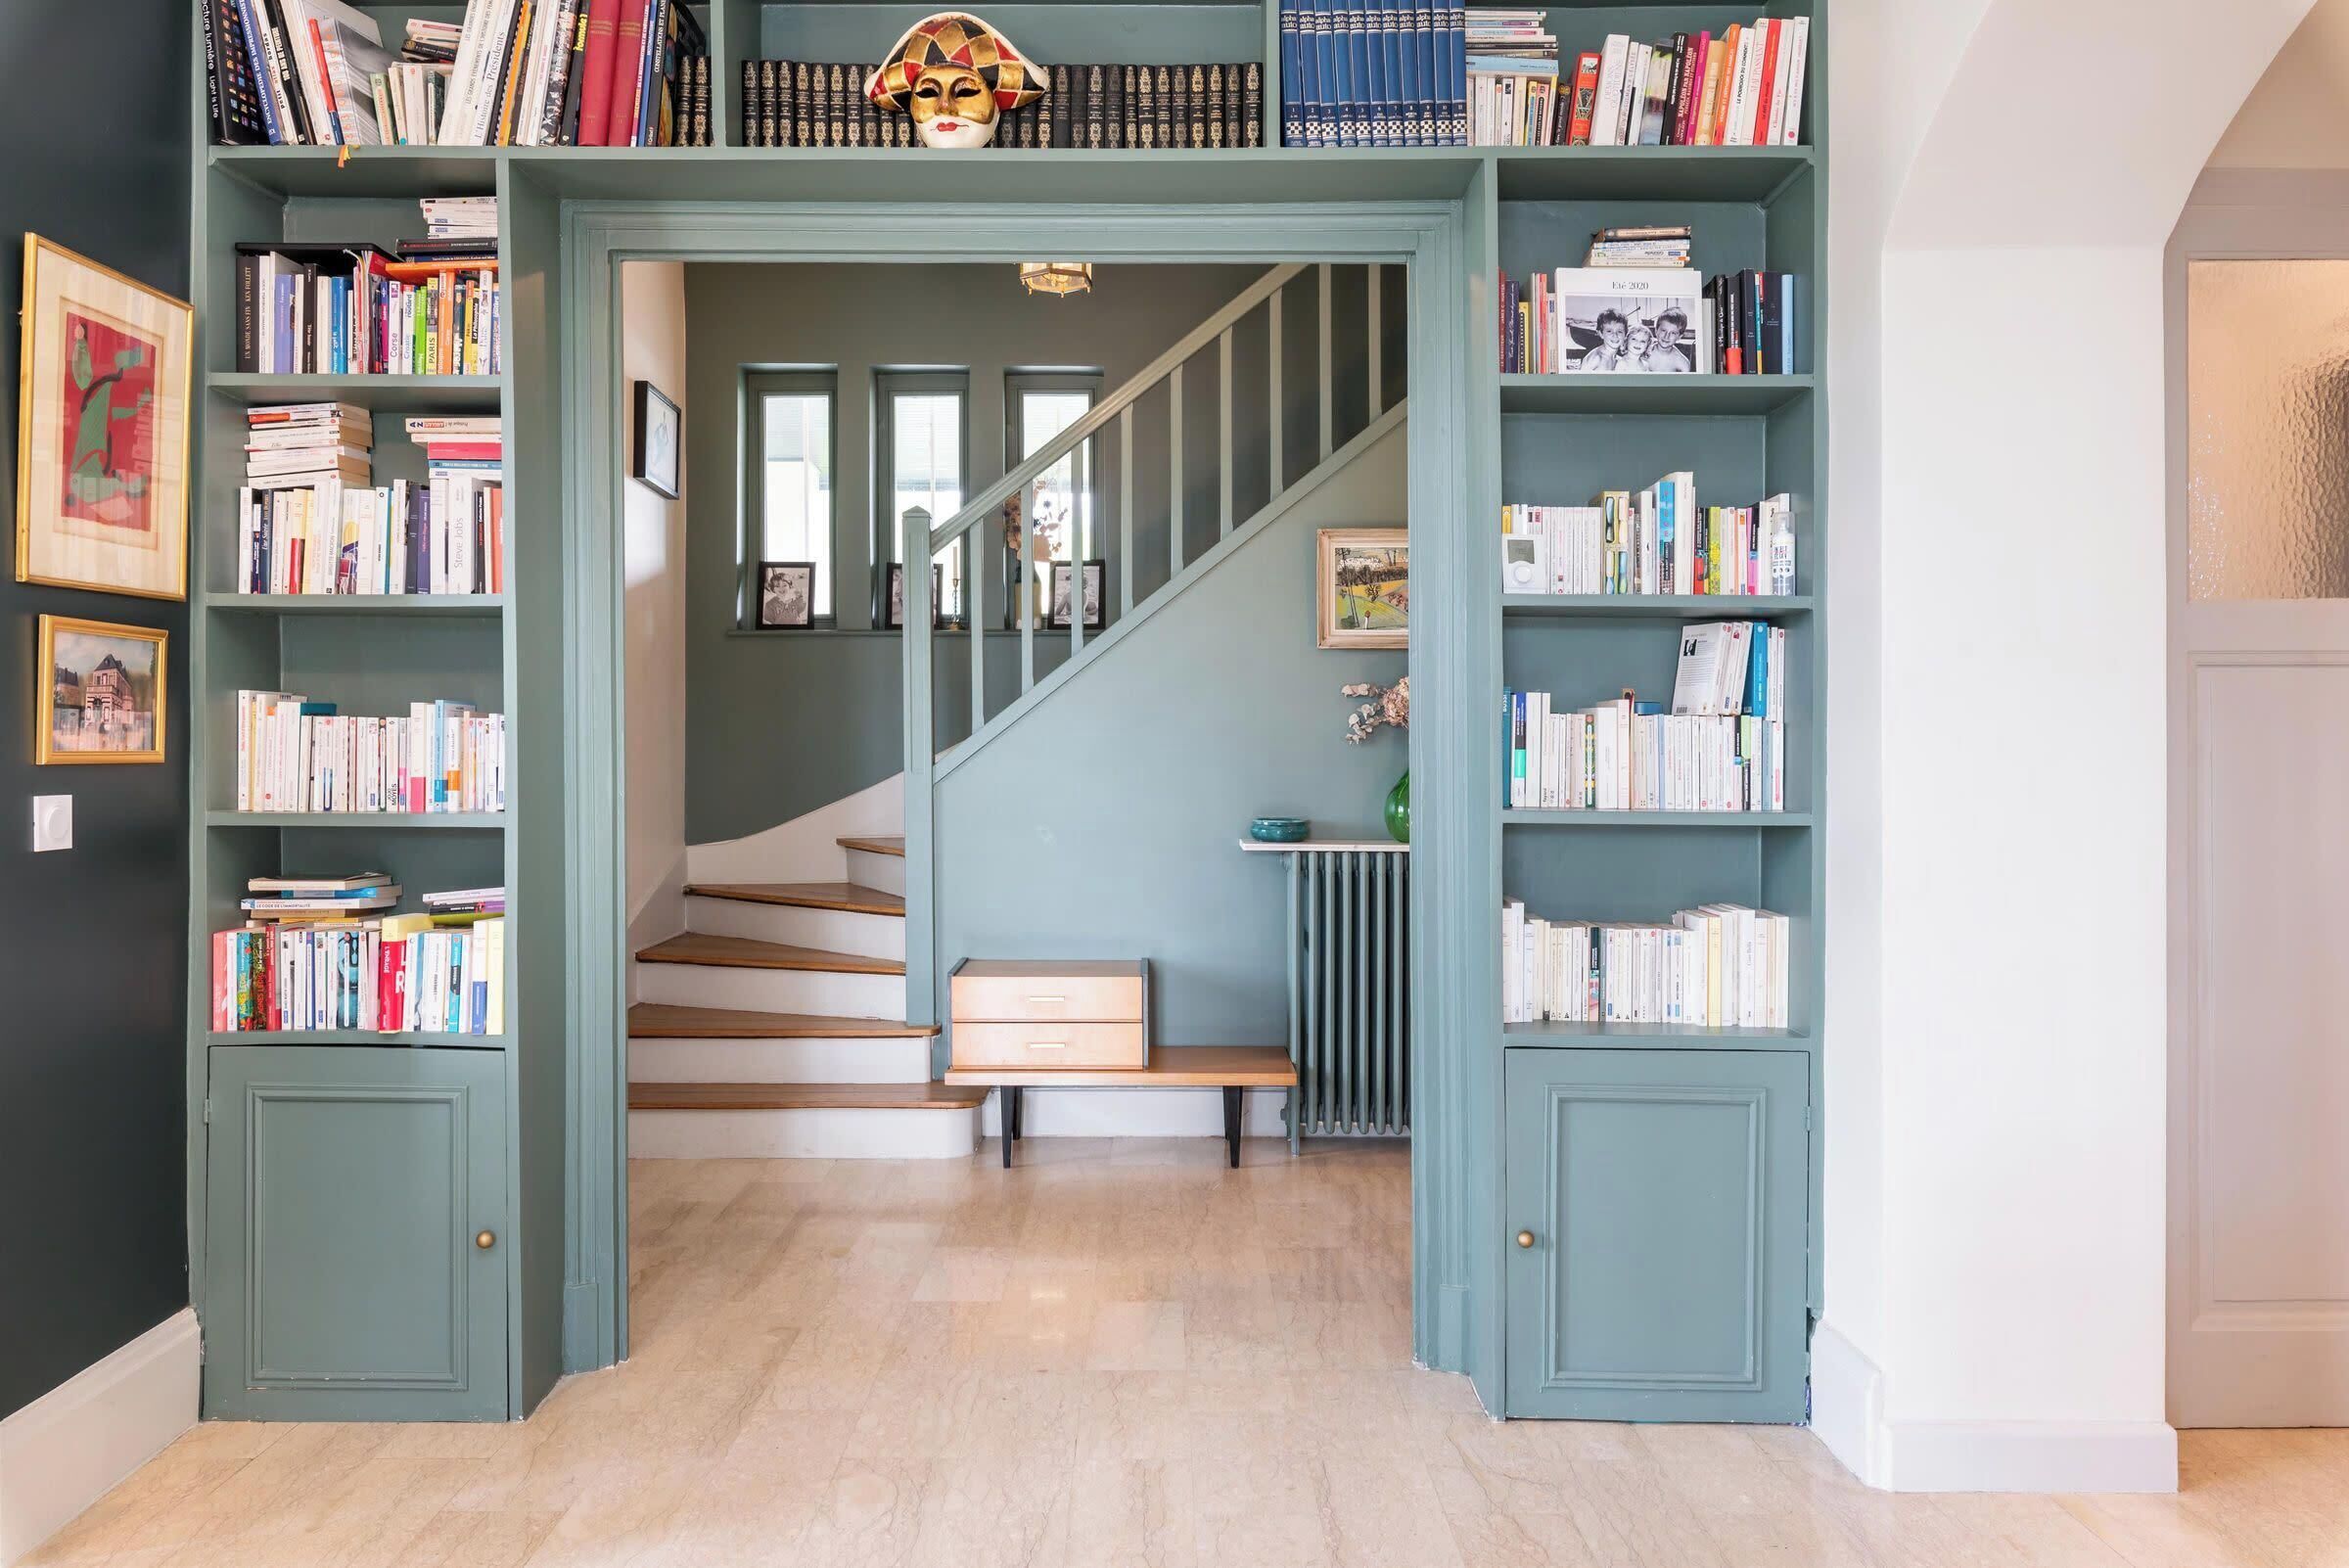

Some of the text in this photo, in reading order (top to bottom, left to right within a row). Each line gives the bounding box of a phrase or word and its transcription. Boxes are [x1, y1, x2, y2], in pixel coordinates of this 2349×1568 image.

[1628, 281, 1649, 291] 2020
[390, 332, 398, 358] Corse
[453, 518, 463, 569] Steve Jobs
